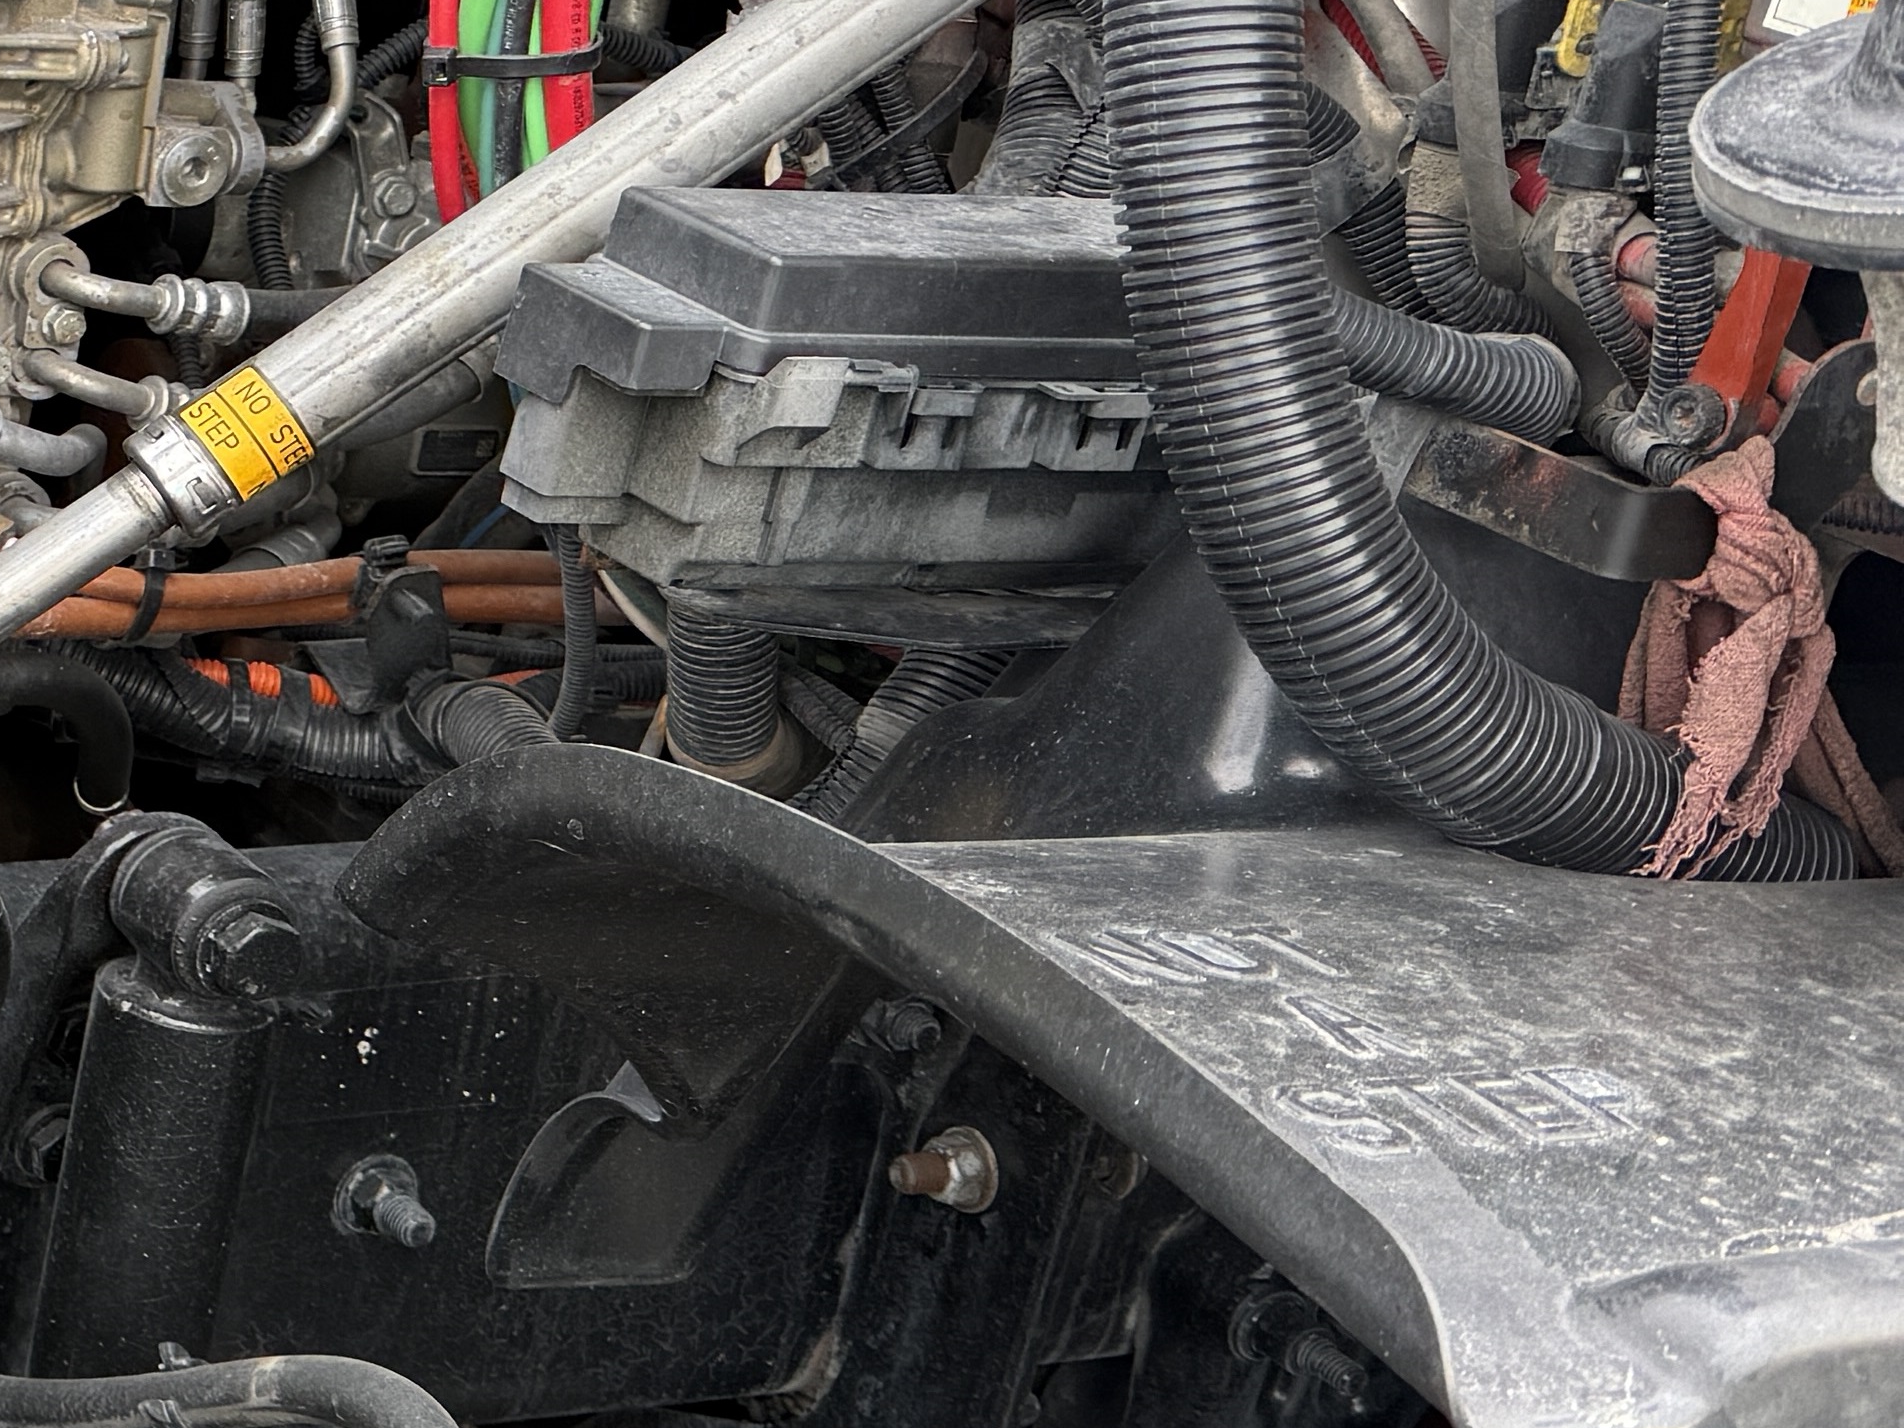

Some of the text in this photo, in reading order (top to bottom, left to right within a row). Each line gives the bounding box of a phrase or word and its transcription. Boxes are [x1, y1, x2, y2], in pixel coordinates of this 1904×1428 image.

[189, 401, 241, 450] STEP
[234, 380, 272, 416] NO
[1037, 922, 1352, 987] NOT
[1278, 992, 1430, 1060] A
[1266, 1066, 1648, 1160] STEP
